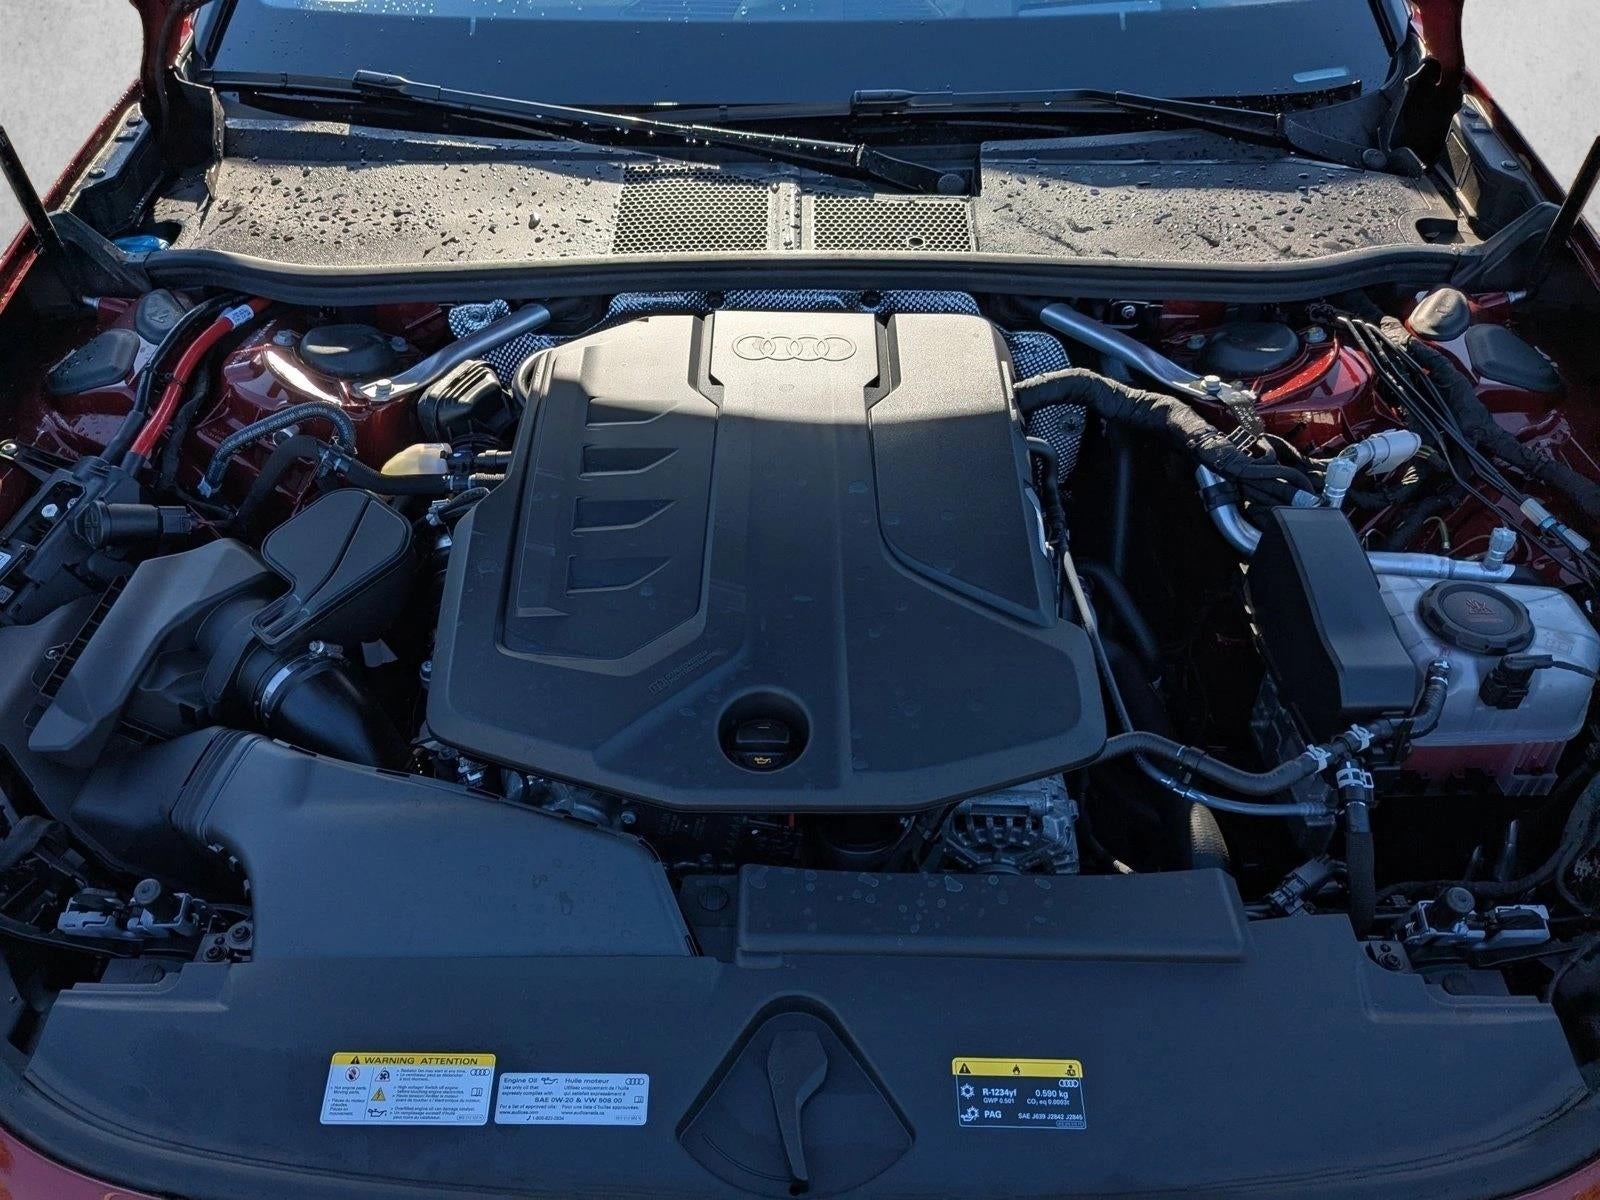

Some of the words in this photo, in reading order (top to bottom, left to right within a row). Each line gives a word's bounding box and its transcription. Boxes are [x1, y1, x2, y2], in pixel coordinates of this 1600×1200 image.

[1035, 1089, 1057, 1097] 0.590
[1059, 1090, 1069, 1100] kg
[984, 1110, 1002, 1118] PAG
